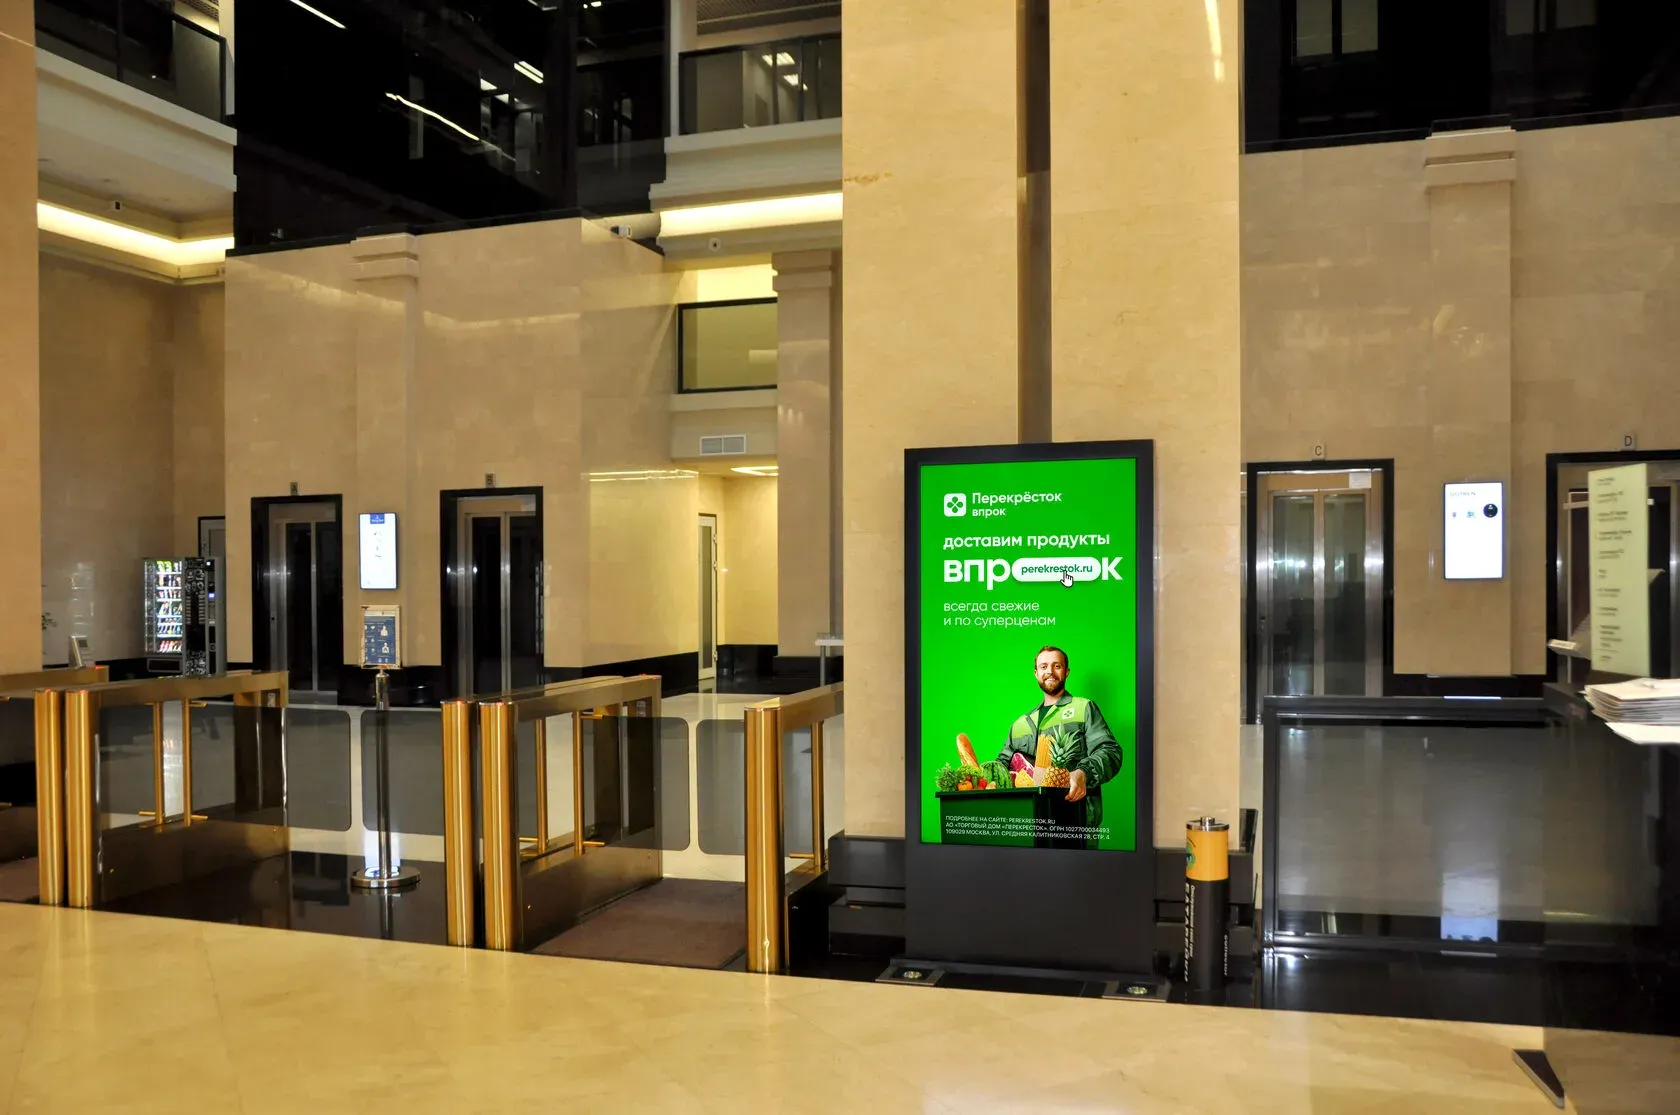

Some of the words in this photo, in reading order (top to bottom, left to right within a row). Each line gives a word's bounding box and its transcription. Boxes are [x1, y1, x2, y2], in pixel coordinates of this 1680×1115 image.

[1624, 435, 1633, 446] D
[1314, 445, 1322, 456] C
[972, 491, 1062, 506] Перекрёсток
[972, 507, 1006, 519] впрок
[943, 535, 1023, 550] доставим
[1027, 533, 1110, 550] продукты
[1021, 563, 1093, 575] perekrestok.ru
[943, 601, 988, 612] всегда
[991, 600, 1040, 611] свежие
[943, 616, 952, 626] и
[955, 616, 971, 626] по
[974, 615, 1056, 629] суперценам
[1009, 817, 1056, 825] PEREKRESTOK.RU
[1028, 831, 1083, 839] КАЛИТНИКОВСКАЯ
